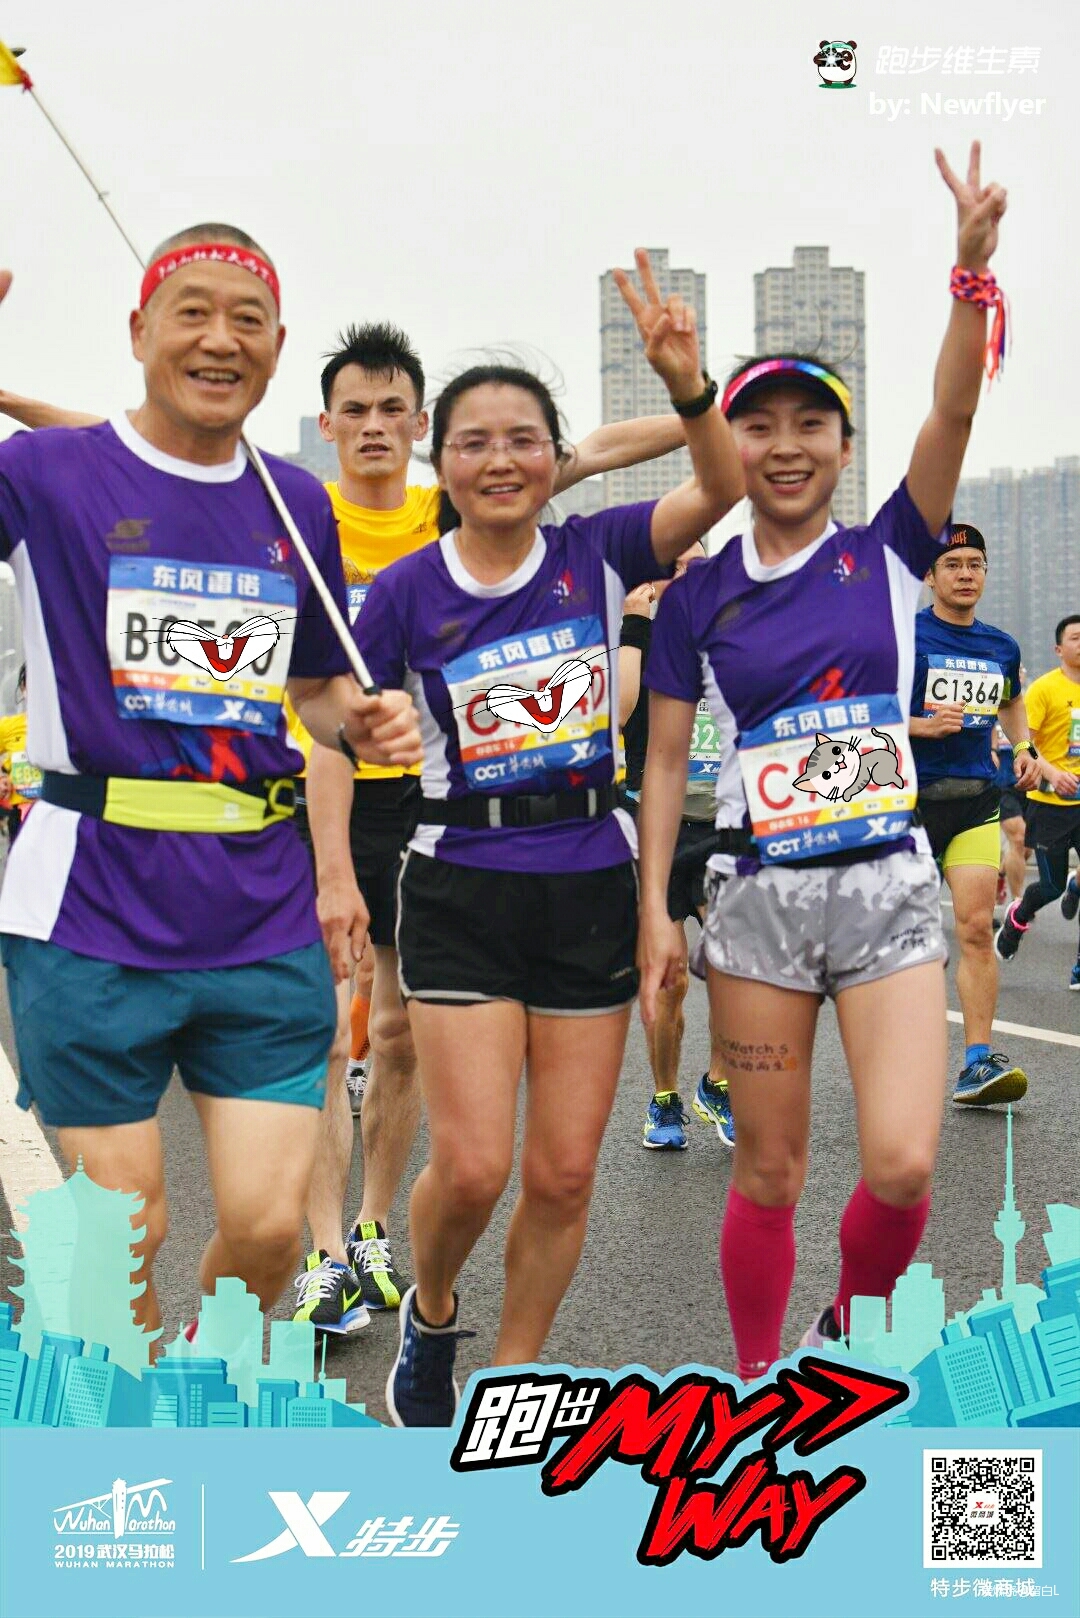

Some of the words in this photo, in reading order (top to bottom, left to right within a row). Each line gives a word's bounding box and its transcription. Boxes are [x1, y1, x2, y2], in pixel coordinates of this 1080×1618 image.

[153, 564, 260, 597] 东风雷诺
[478, 627, 576, 670] 东风雷诺
[945, 658, 988, 671] 东风雷诺
[931, 677, 999, 705] C1364
[773, 703, 870, 738] 东风雷诺
[474, 762, 506, 781] OCT
[767, 838, 801, 857] OCT
